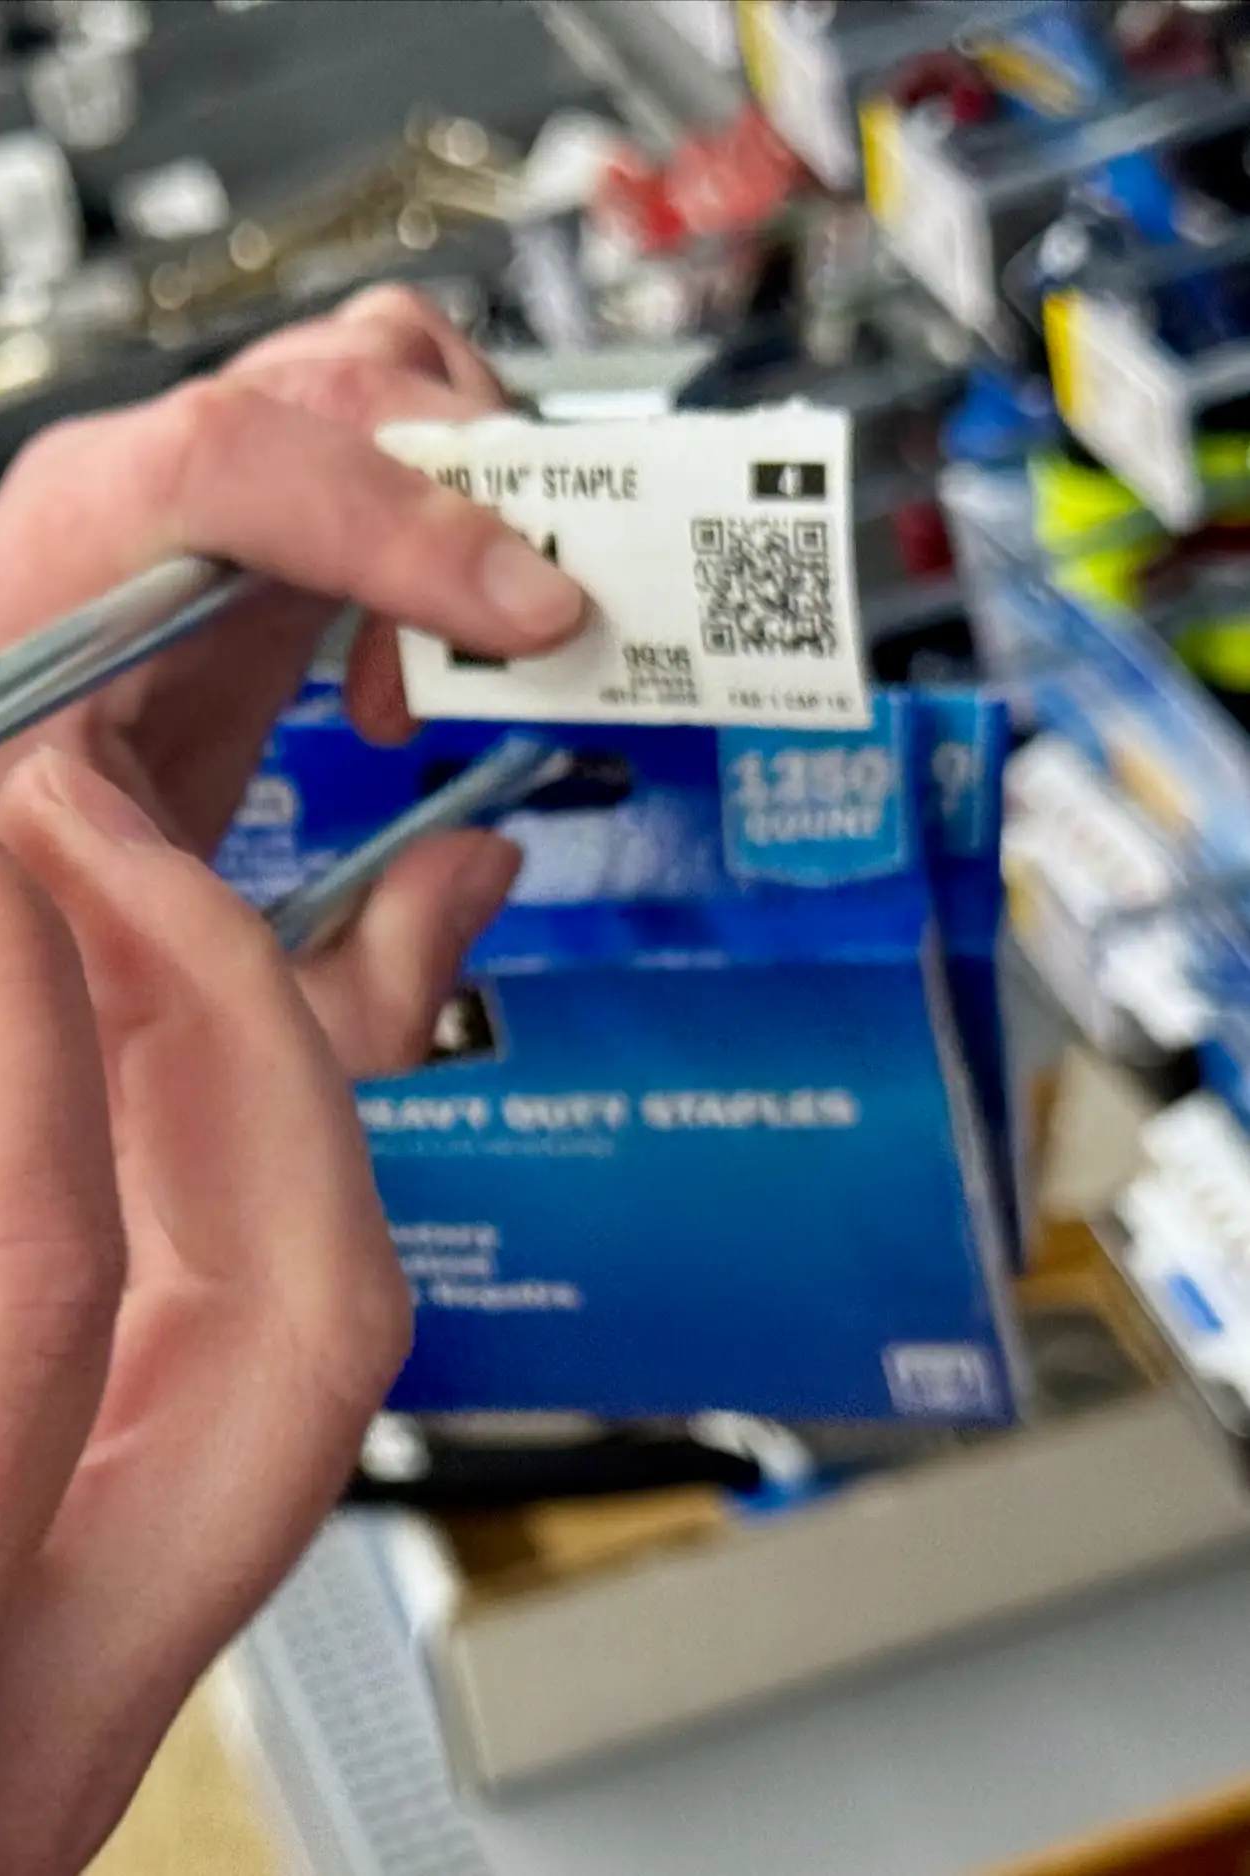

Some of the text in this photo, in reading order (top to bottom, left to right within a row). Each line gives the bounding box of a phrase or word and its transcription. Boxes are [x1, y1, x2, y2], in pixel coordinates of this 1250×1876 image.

[542, 463, 638, 501] STAPLE
[356, 1089, 857, 1131] EAVY DUTY STAPLES
